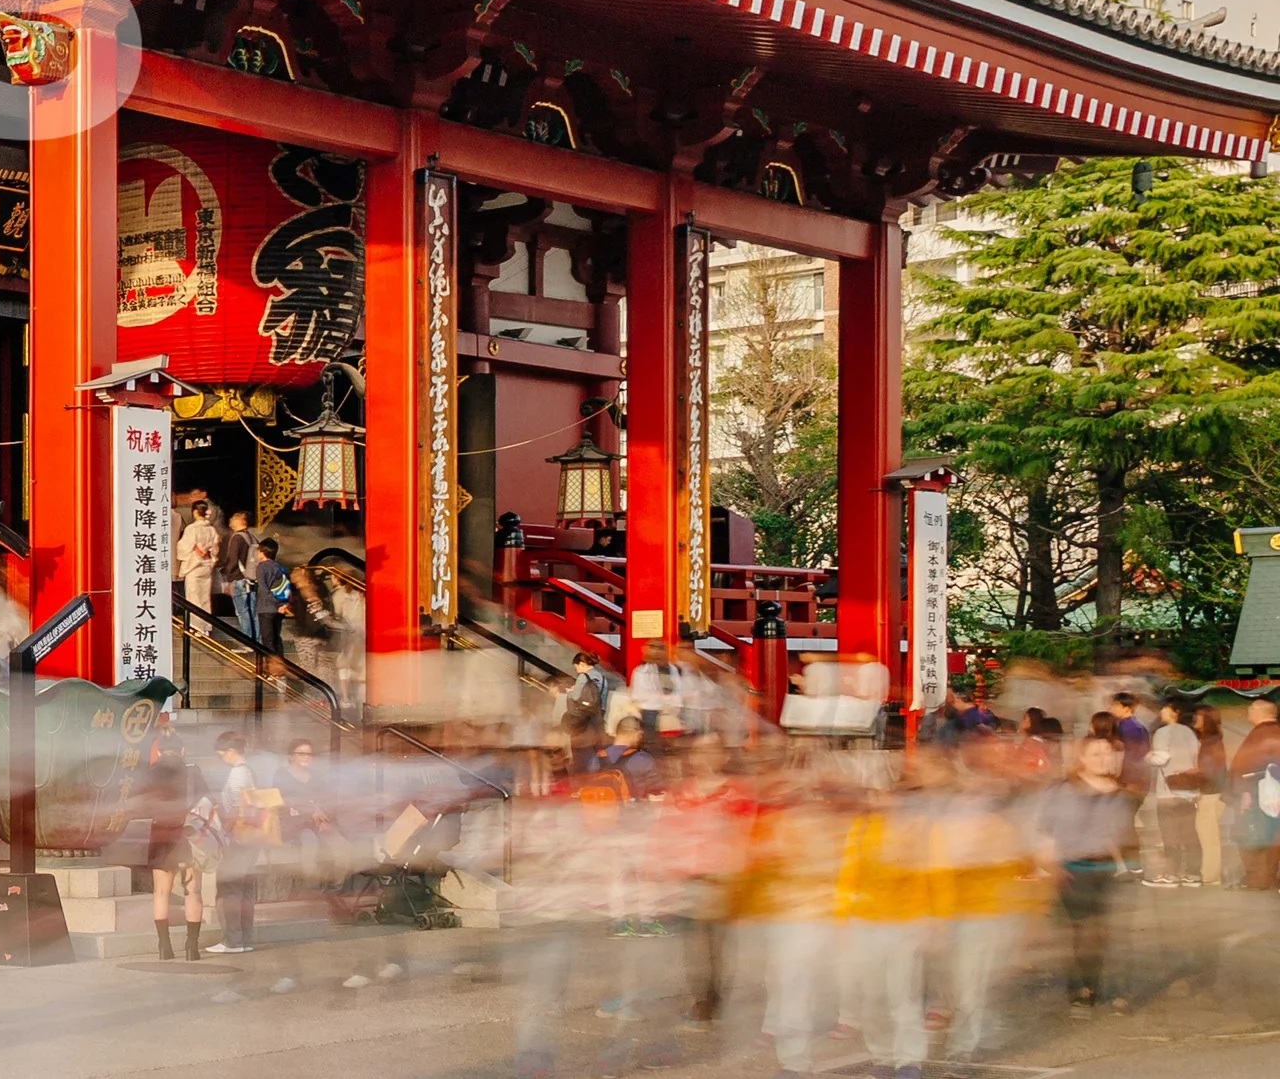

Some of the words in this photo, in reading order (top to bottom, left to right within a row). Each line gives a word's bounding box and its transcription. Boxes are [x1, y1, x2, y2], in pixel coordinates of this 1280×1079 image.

[195, 208, 217, 315] 東京新橋組合
